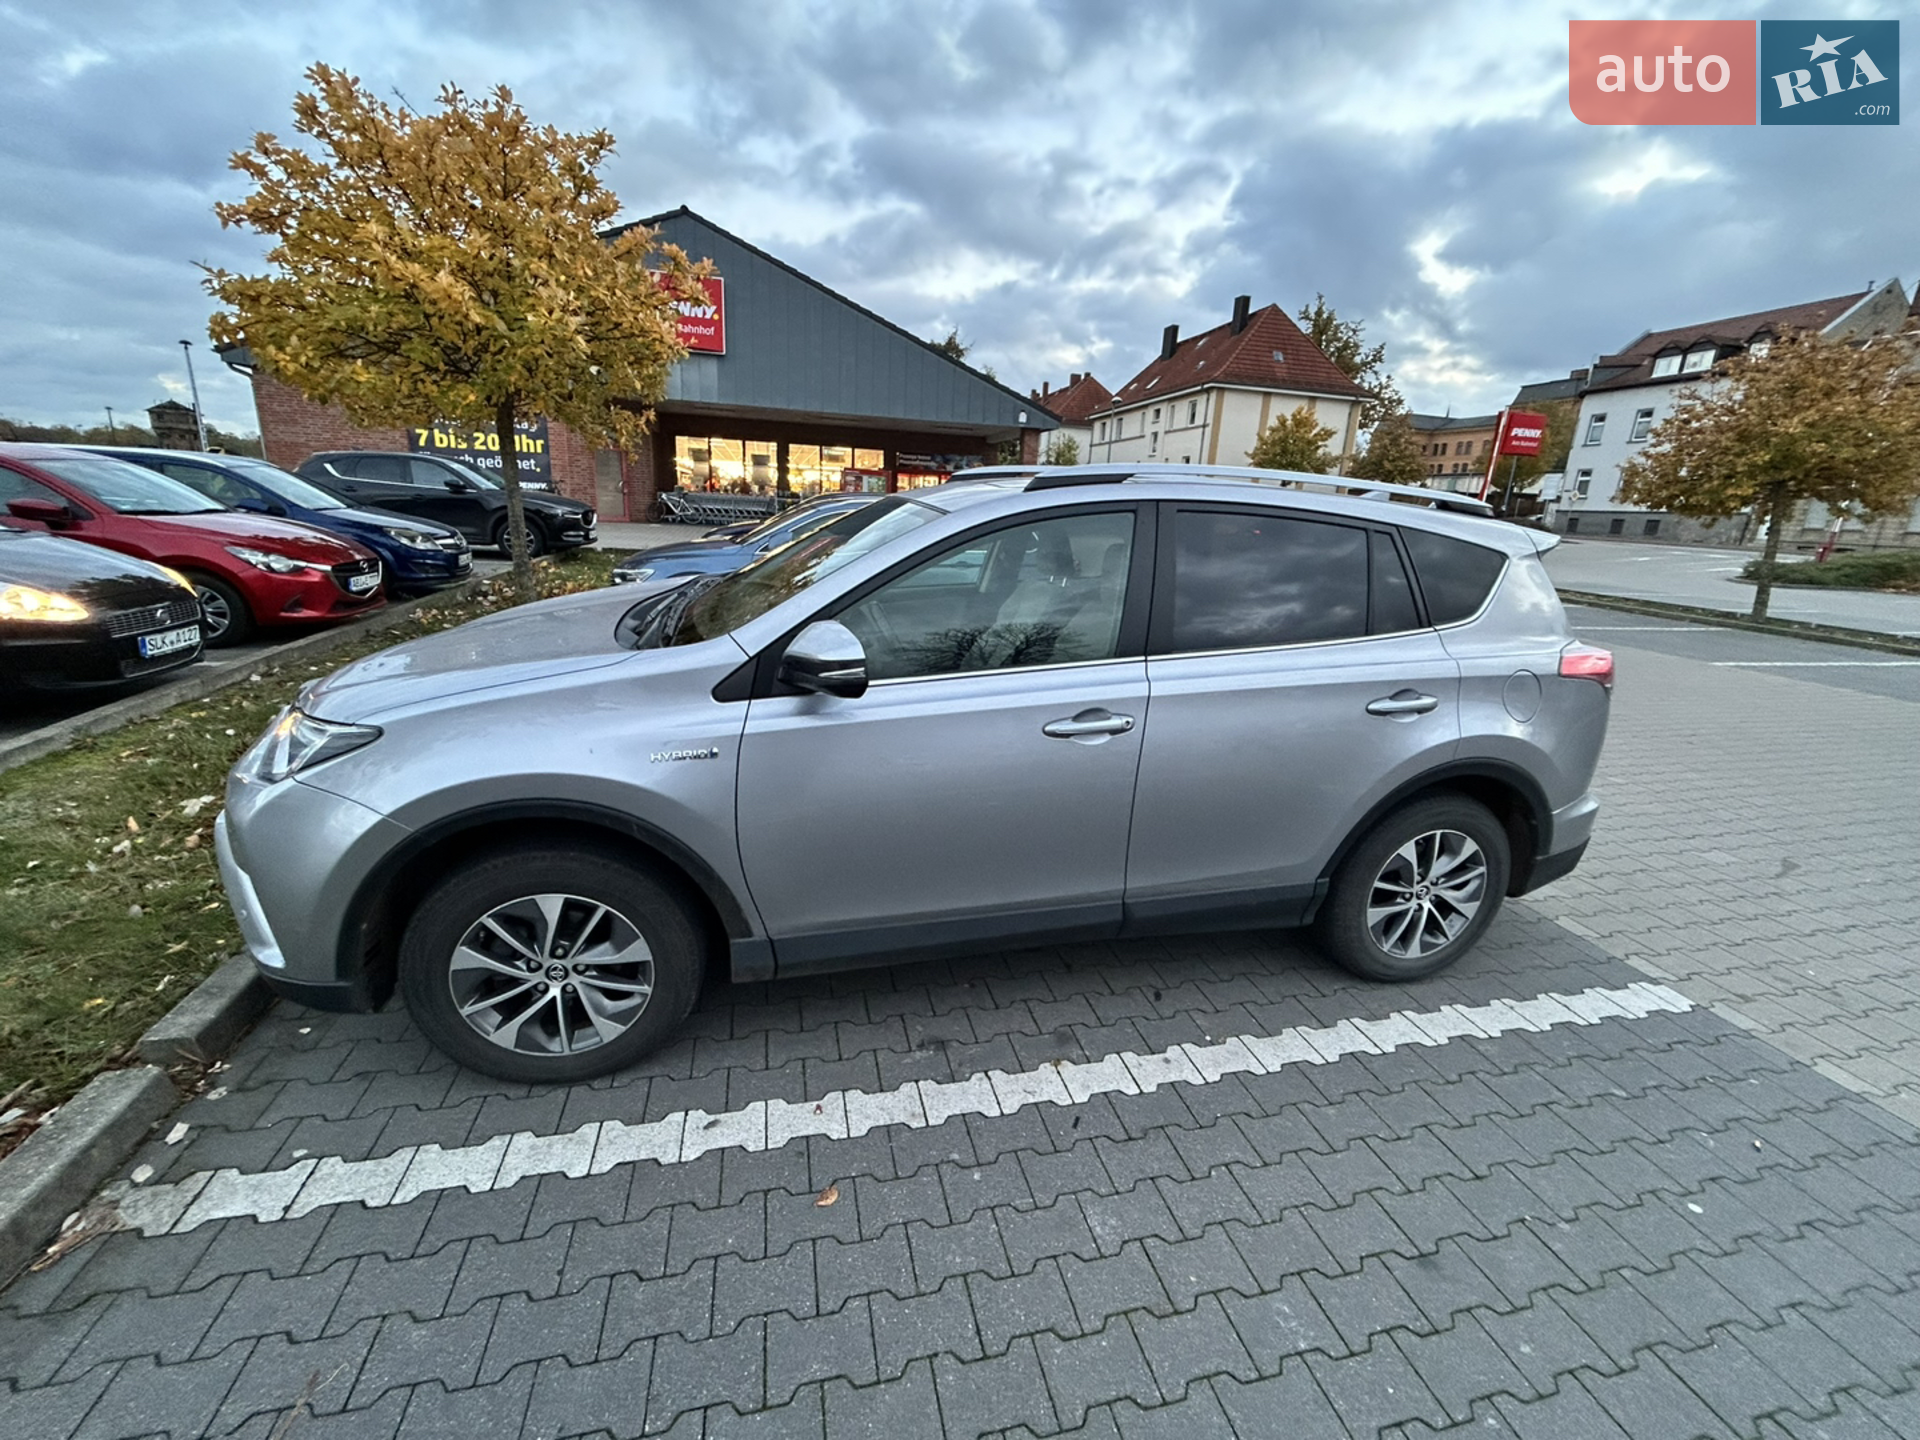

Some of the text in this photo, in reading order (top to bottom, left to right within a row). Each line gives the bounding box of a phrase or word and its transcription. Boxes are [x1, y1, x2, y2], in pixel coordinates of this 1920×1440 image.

[415, 428, 429, 447] 7
[433, 427, 468, 449] bis
[473, 432, 500, 451] 20
[147, 626, 198, 652] SLK A127
[650, 749, 708, 762] HYBRID
